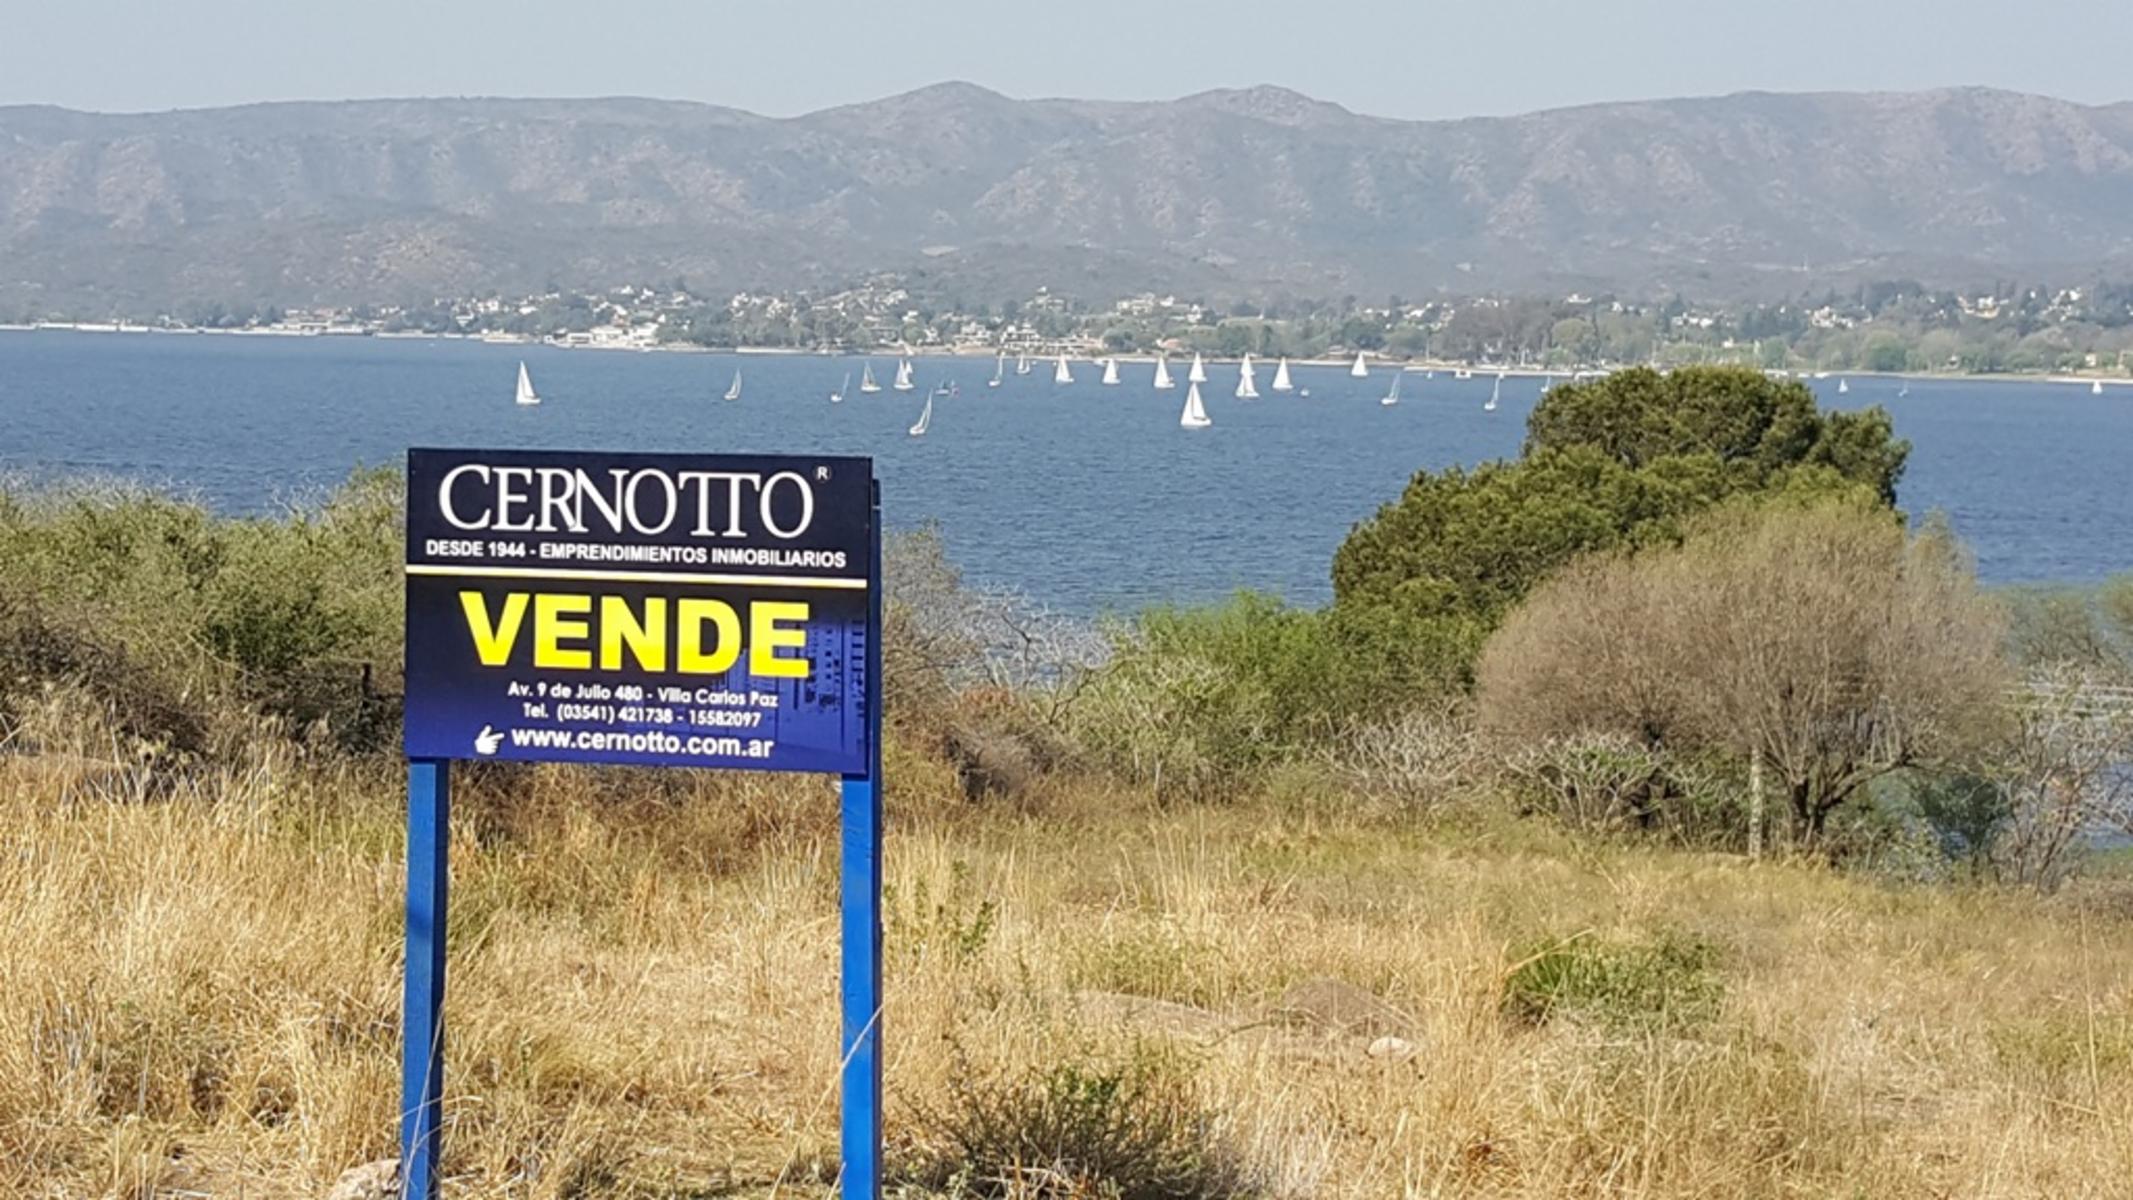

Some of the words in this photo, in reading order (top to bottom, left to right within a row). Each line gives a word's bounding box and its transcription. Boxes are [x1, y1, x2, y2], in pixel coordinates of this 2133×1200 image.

[438, 464, 814, 539] CERNOTTO
[426, 540, 484, 557] DESDE
[488, 542, 526, 558] 1944
[539, 542, 708, 564] EMPRENDIMIENTOS
[711, 547, 847, 568] INMOBILIARIOS
[459, 591, 810, 678] VENDE
[508, 681, 534, 697] Av.
[537, 682, 547, 697] 9
[550, 682, 572, 699] de
[574, 684, 612, 700] Julio
[614, 685, 643, 701] 480
[657, 686, 692, 703] Villa
[695, 688, 747, 706] Carlos
[750, 690, 779, 708] Paz
[523, 702, 549, 719] Tel.
[557, 703, 615, 725] (03541)
[618, 706, 674, 724] 421738
[689, 709, 762, 728] 15582097
[511, 727, 775, 758] www.cernotto.com.ar
